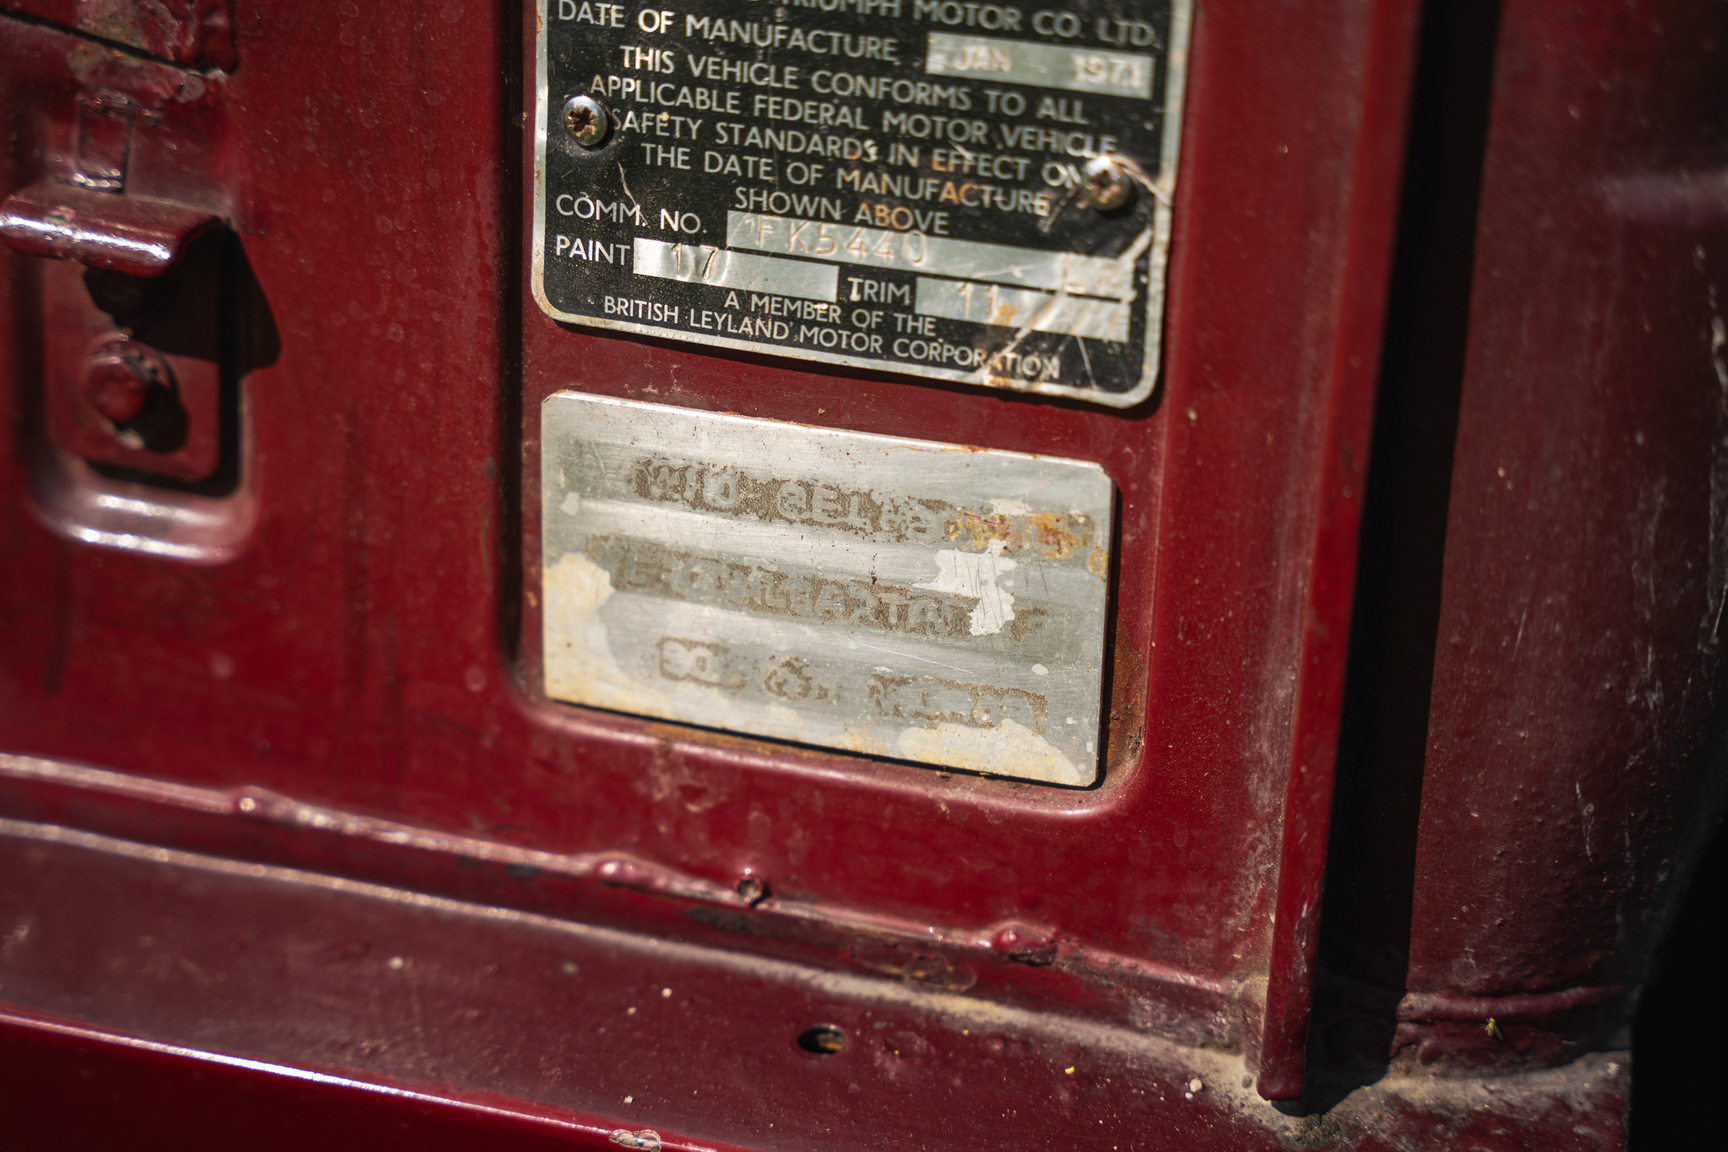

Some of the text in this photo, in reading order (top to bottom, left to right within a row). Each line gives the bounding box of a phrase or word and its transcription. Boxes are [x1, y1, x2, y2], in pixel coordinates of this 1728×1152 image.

[558, 0, 626, 28] DATE
[638, 9, 675, 34] OF
[686, 15, 899, 61] MANUFACTURE
[781, 0, 901, 18] UMPH
[912, 0, 1022, 32] MOTOR
[590, 74, 1118, 158] APPLICABLE FEDERAL MOTOR VEHICLE
[620, 45, 1090, 125] THIS VEHICLE CONFORMS TO ALL
[611, 107, 703, 140] SAFETY
[716, 122, 878, 163] STANDARDS
[889, 143, 919, 168] IN
[932, 148, 1031, 182] EFFECT
[641, 143, 1052, 218] THE DATE OF MANUFACTURE
[735, 186, 949, 236] SHOWN ABOVE
[660, 208, 707, 234] NO.
[555, 235, 631, 266] PAINT
[672, 242, 720, 281] 17
[847, 276, 911, 306] TRIM
[604, 296, 1061, 380] BRITISH LEYLAND MOTOR CORPORATION
[724, 290, 937, 337] A MEMBER OF THE
